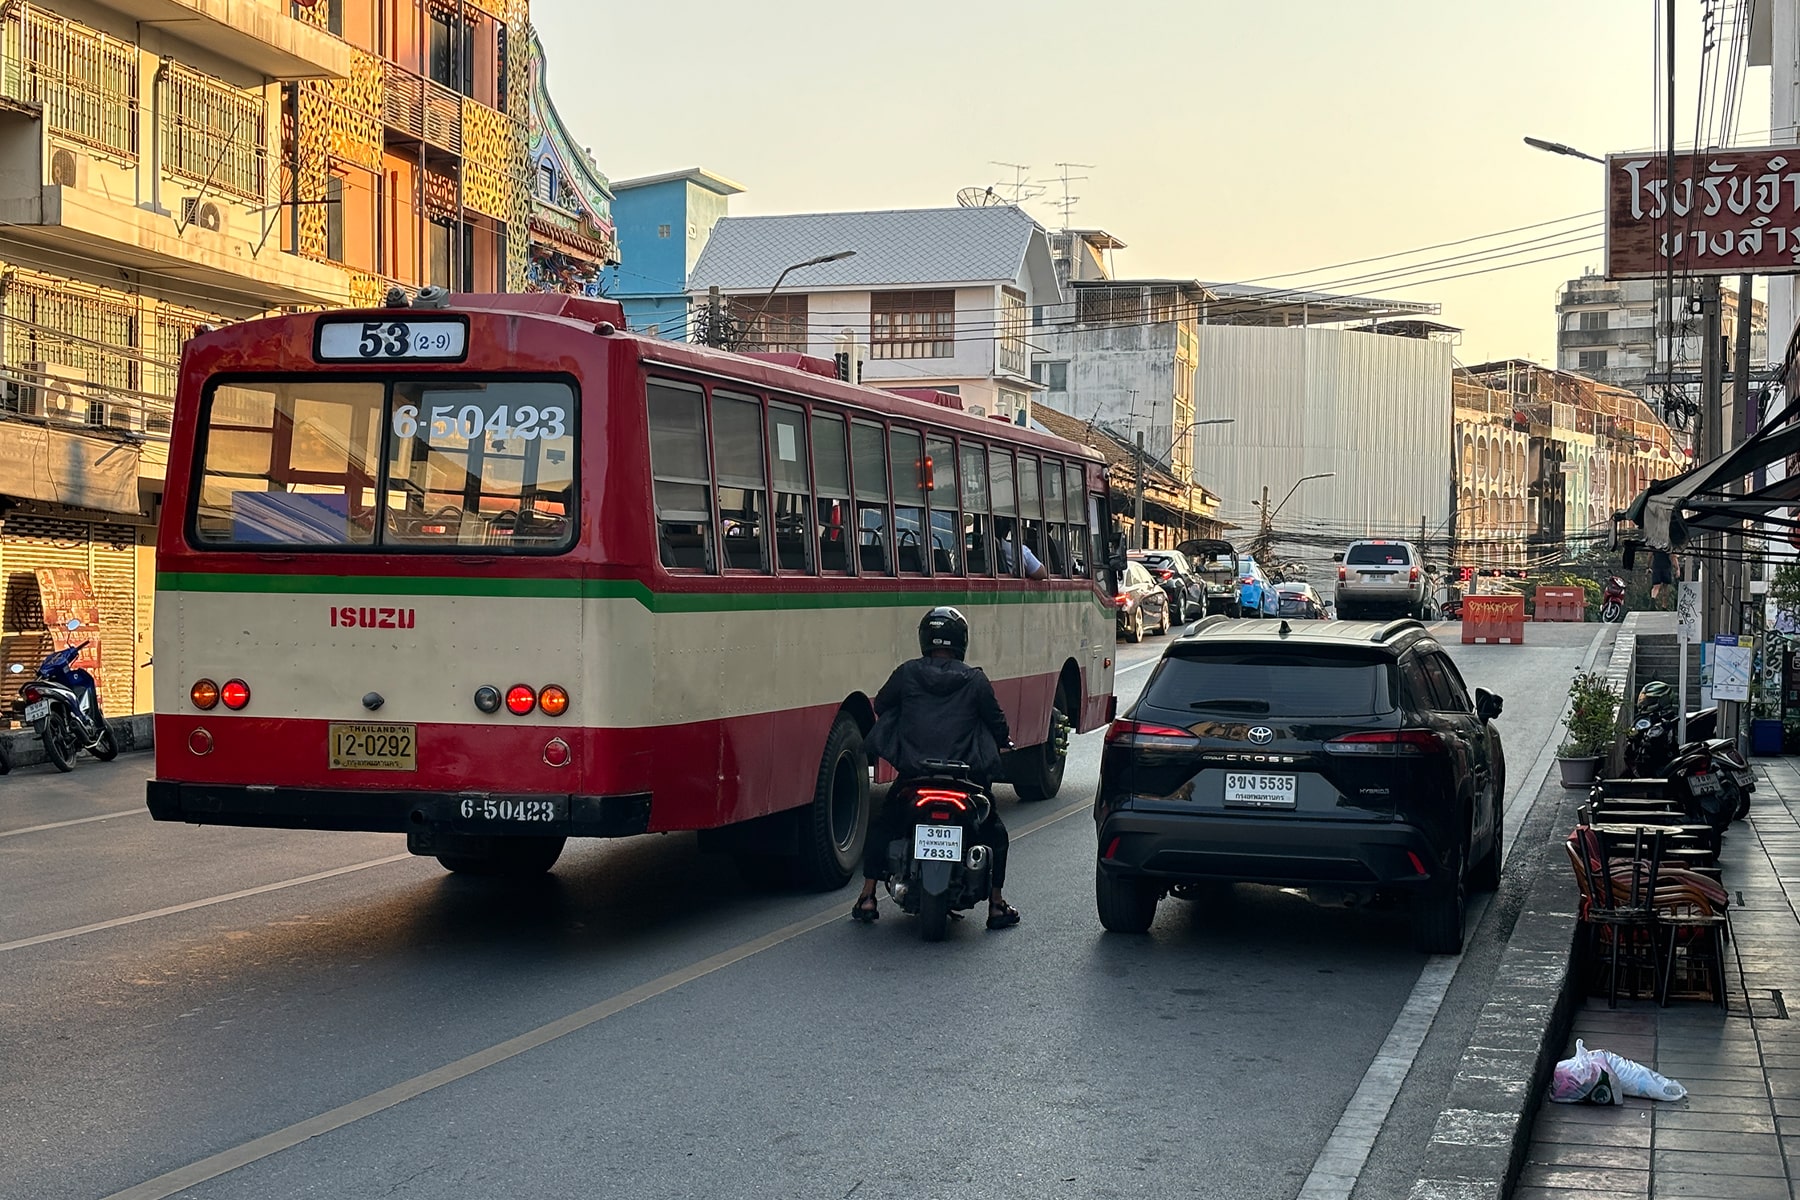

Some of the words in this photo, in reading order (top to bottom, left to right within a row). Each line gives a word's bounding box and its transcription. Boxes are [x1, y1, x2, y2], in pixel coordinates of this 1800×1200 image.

[358, 322, 410, 357] 53
[413, 332, 451, 351] (2-9)
[393, 404, 566, 440] 6-50423
[330, 606, 415, 629] ISUZU
[349, 725, 396, 733] THAILAND
[337, 734, 411, 757] 12-0292
[1226, 754, 1294, 763] CROSS
[1228, 775, 1257, 790] 3ขง
[1259, 776, 1294, 791] 5535
[460, 799, 554, 822] 6-50423
[922, 848, 954, 859] 7833
